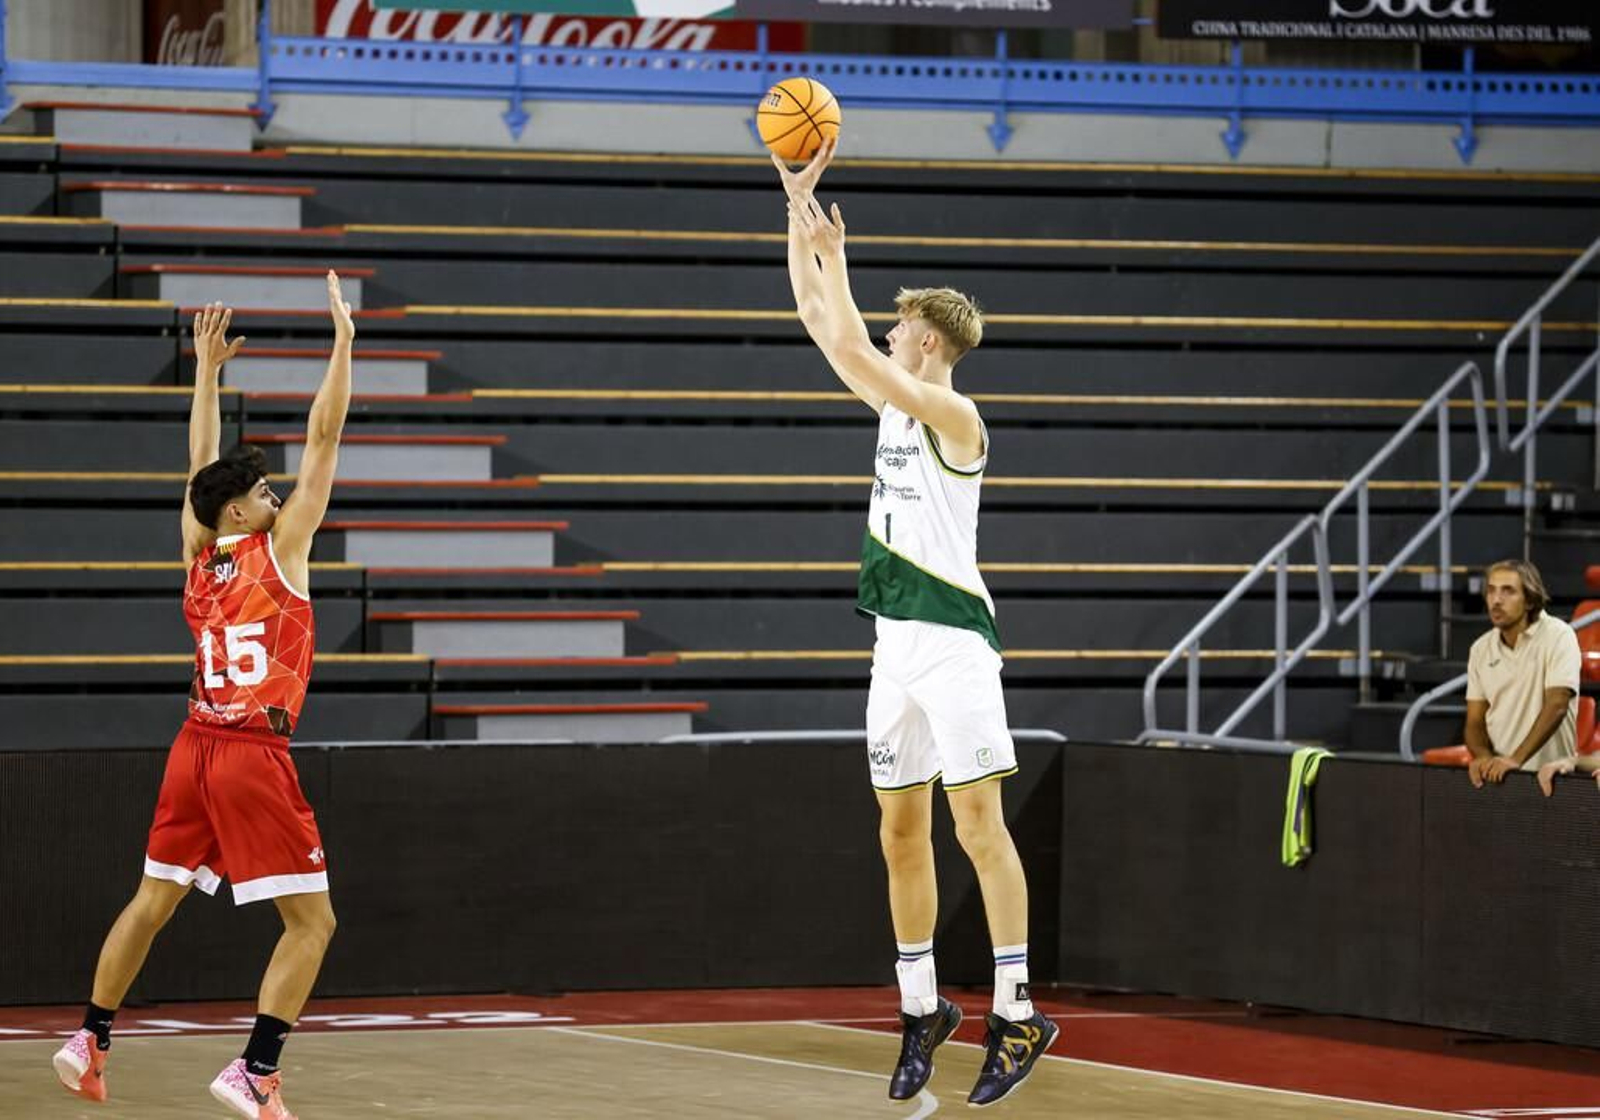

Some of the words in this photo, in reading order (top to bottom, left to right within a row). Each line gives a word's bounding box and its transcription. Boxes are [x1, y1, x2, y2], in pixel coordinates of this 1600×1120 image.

[1240, 22, 1332, 38] TRADICIONAL
[885, 513, 892, 544] 1
[200, 622, 267, 688] 15
